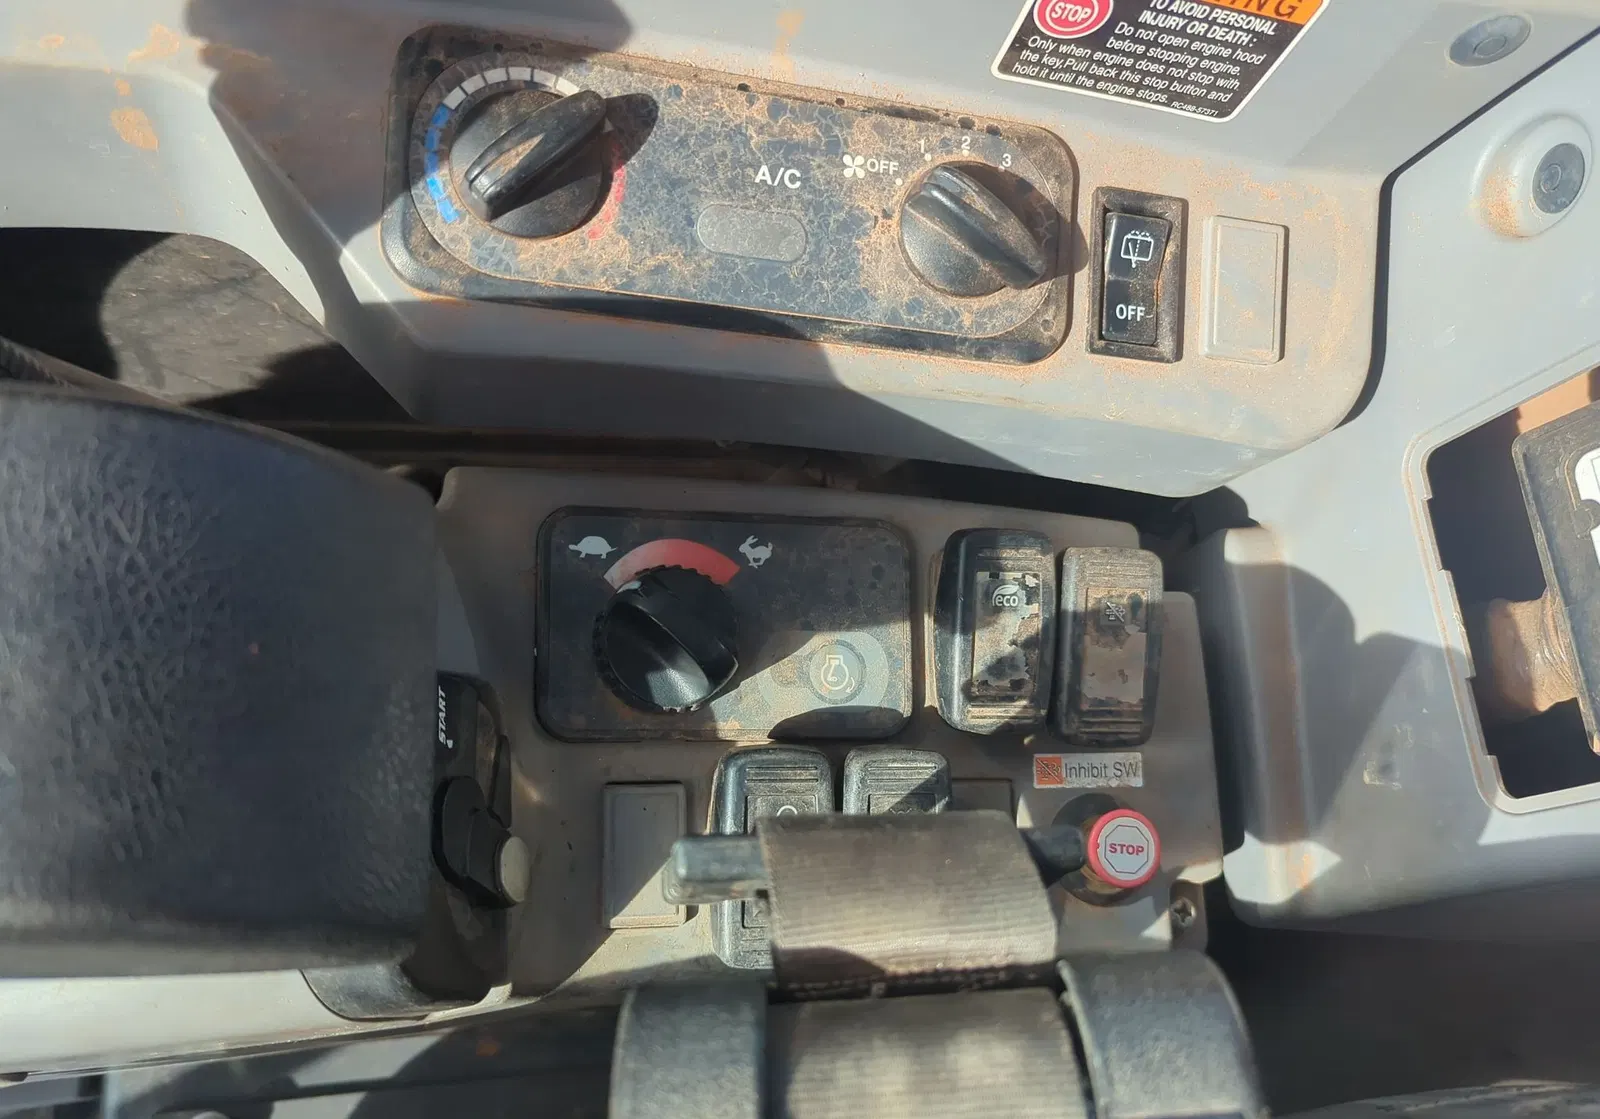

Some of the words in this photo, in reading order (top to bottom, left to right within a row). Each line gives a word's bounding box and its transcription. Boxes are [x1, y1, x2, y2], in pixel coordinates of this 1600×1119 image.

[1051, 2, 1092, 23] STOP
[1138, 10, 1188, 31] INJURY
[1186, 20, 1208, 36] OR
[1168, 0, 1210, 19] AVOID
[1209, 8, 1278, 35] PERSONAL
[1106, 36, 1146, 55] before
[1147, 47, 1199, 68] stopping
[1200, 59, 1241, 76] engine.
[1114, 22, 1134, 36] Do
[1135, 28, 1158, 41] not
[1158, 34, 1189, 48] open
[1191, 41, 1232, 58] engine
[1232, 48, 1267, 65] hood
[1020, 49, 1040, 62] the
[1088, 63, 1118, 79] back
[1119, 70, 1141, 84] this
[1143, 76, 1169, 90] stop
[1169, 80, 1207, 97] button
[1207, 91, 1233, 103] and
[1028, 35, 1058, 53] Only
[1059, 43, 1091, 58] when
[1093, 51, 1134, 67] engine
[1136, 59, 1166, 74] does
[1166, 66, 1188, 79] not
[1188, 71, 1214, 85] stop
[1216, 77, 1240, 90] with
[1012, 62, 1039, 76] hold
[1039, 67, 1049, 79] it
[1049, 71, 1075, 84] until
[1075, 75, 1095, 88] the
[1096, 80, 1135, 96] engine
[1136, 88, 1168, 104] stops.
[920, 139, 925, 154] 1
[961, 136, 971, 150] 2
[1002, 153, 1012, 167] 3
[754, 164, 802, 189] A/C
[866, 158, 900, 175] OFF
[1115, 303, 1146, 322] OFF
[995, 594, 1019, 607] eco
[438, 684, 447, 745] START
[1064, 762, 1108, 778] Inhibit
[1113, 761, 1139, 778] SW
[1109, 843, 1145, 856] STOP
